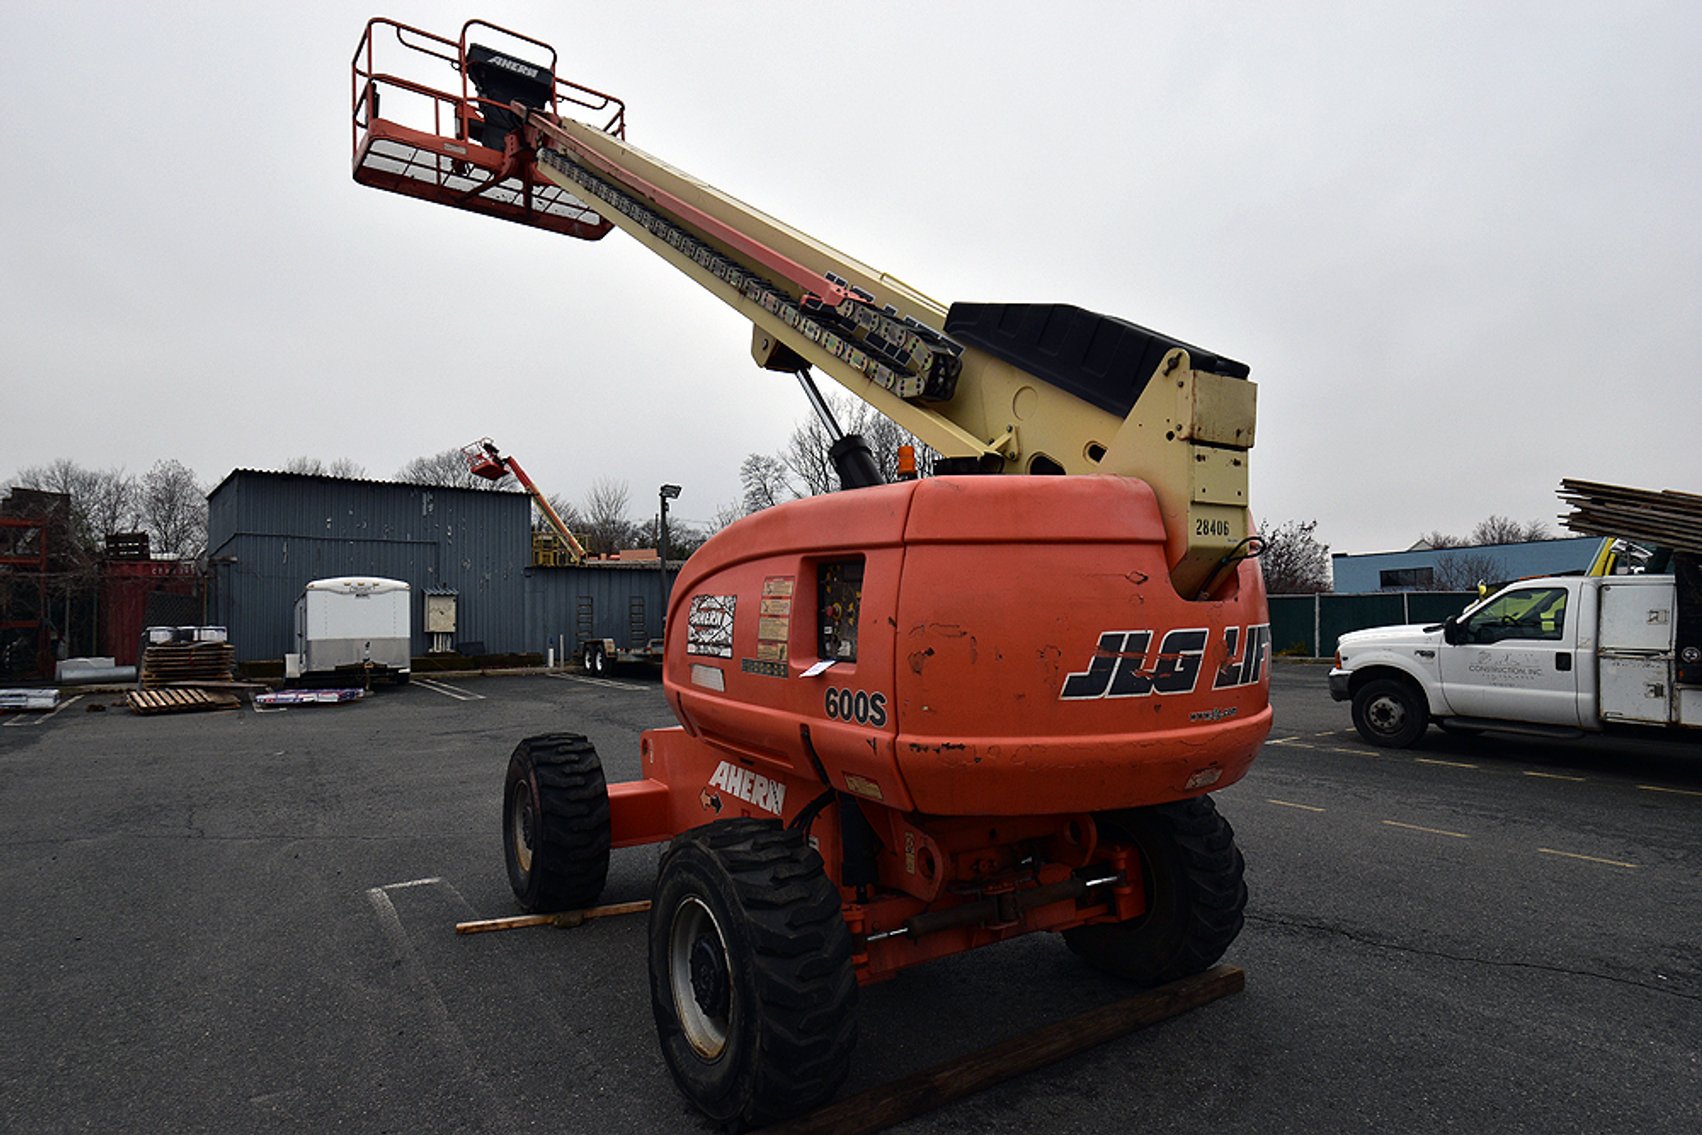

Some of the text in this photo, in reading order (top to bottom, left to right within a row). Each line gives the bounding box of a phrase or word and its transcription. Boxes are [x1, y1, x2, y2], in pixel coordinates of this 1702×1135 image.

[487, 56, 539, 78] AHERN
[1196, 518, 1230, 536] 28406
[1058, 628, 1209, 700] JLG
[825, 687, 887, 727] 600S
[708, 760, 786, 816] AHERN
